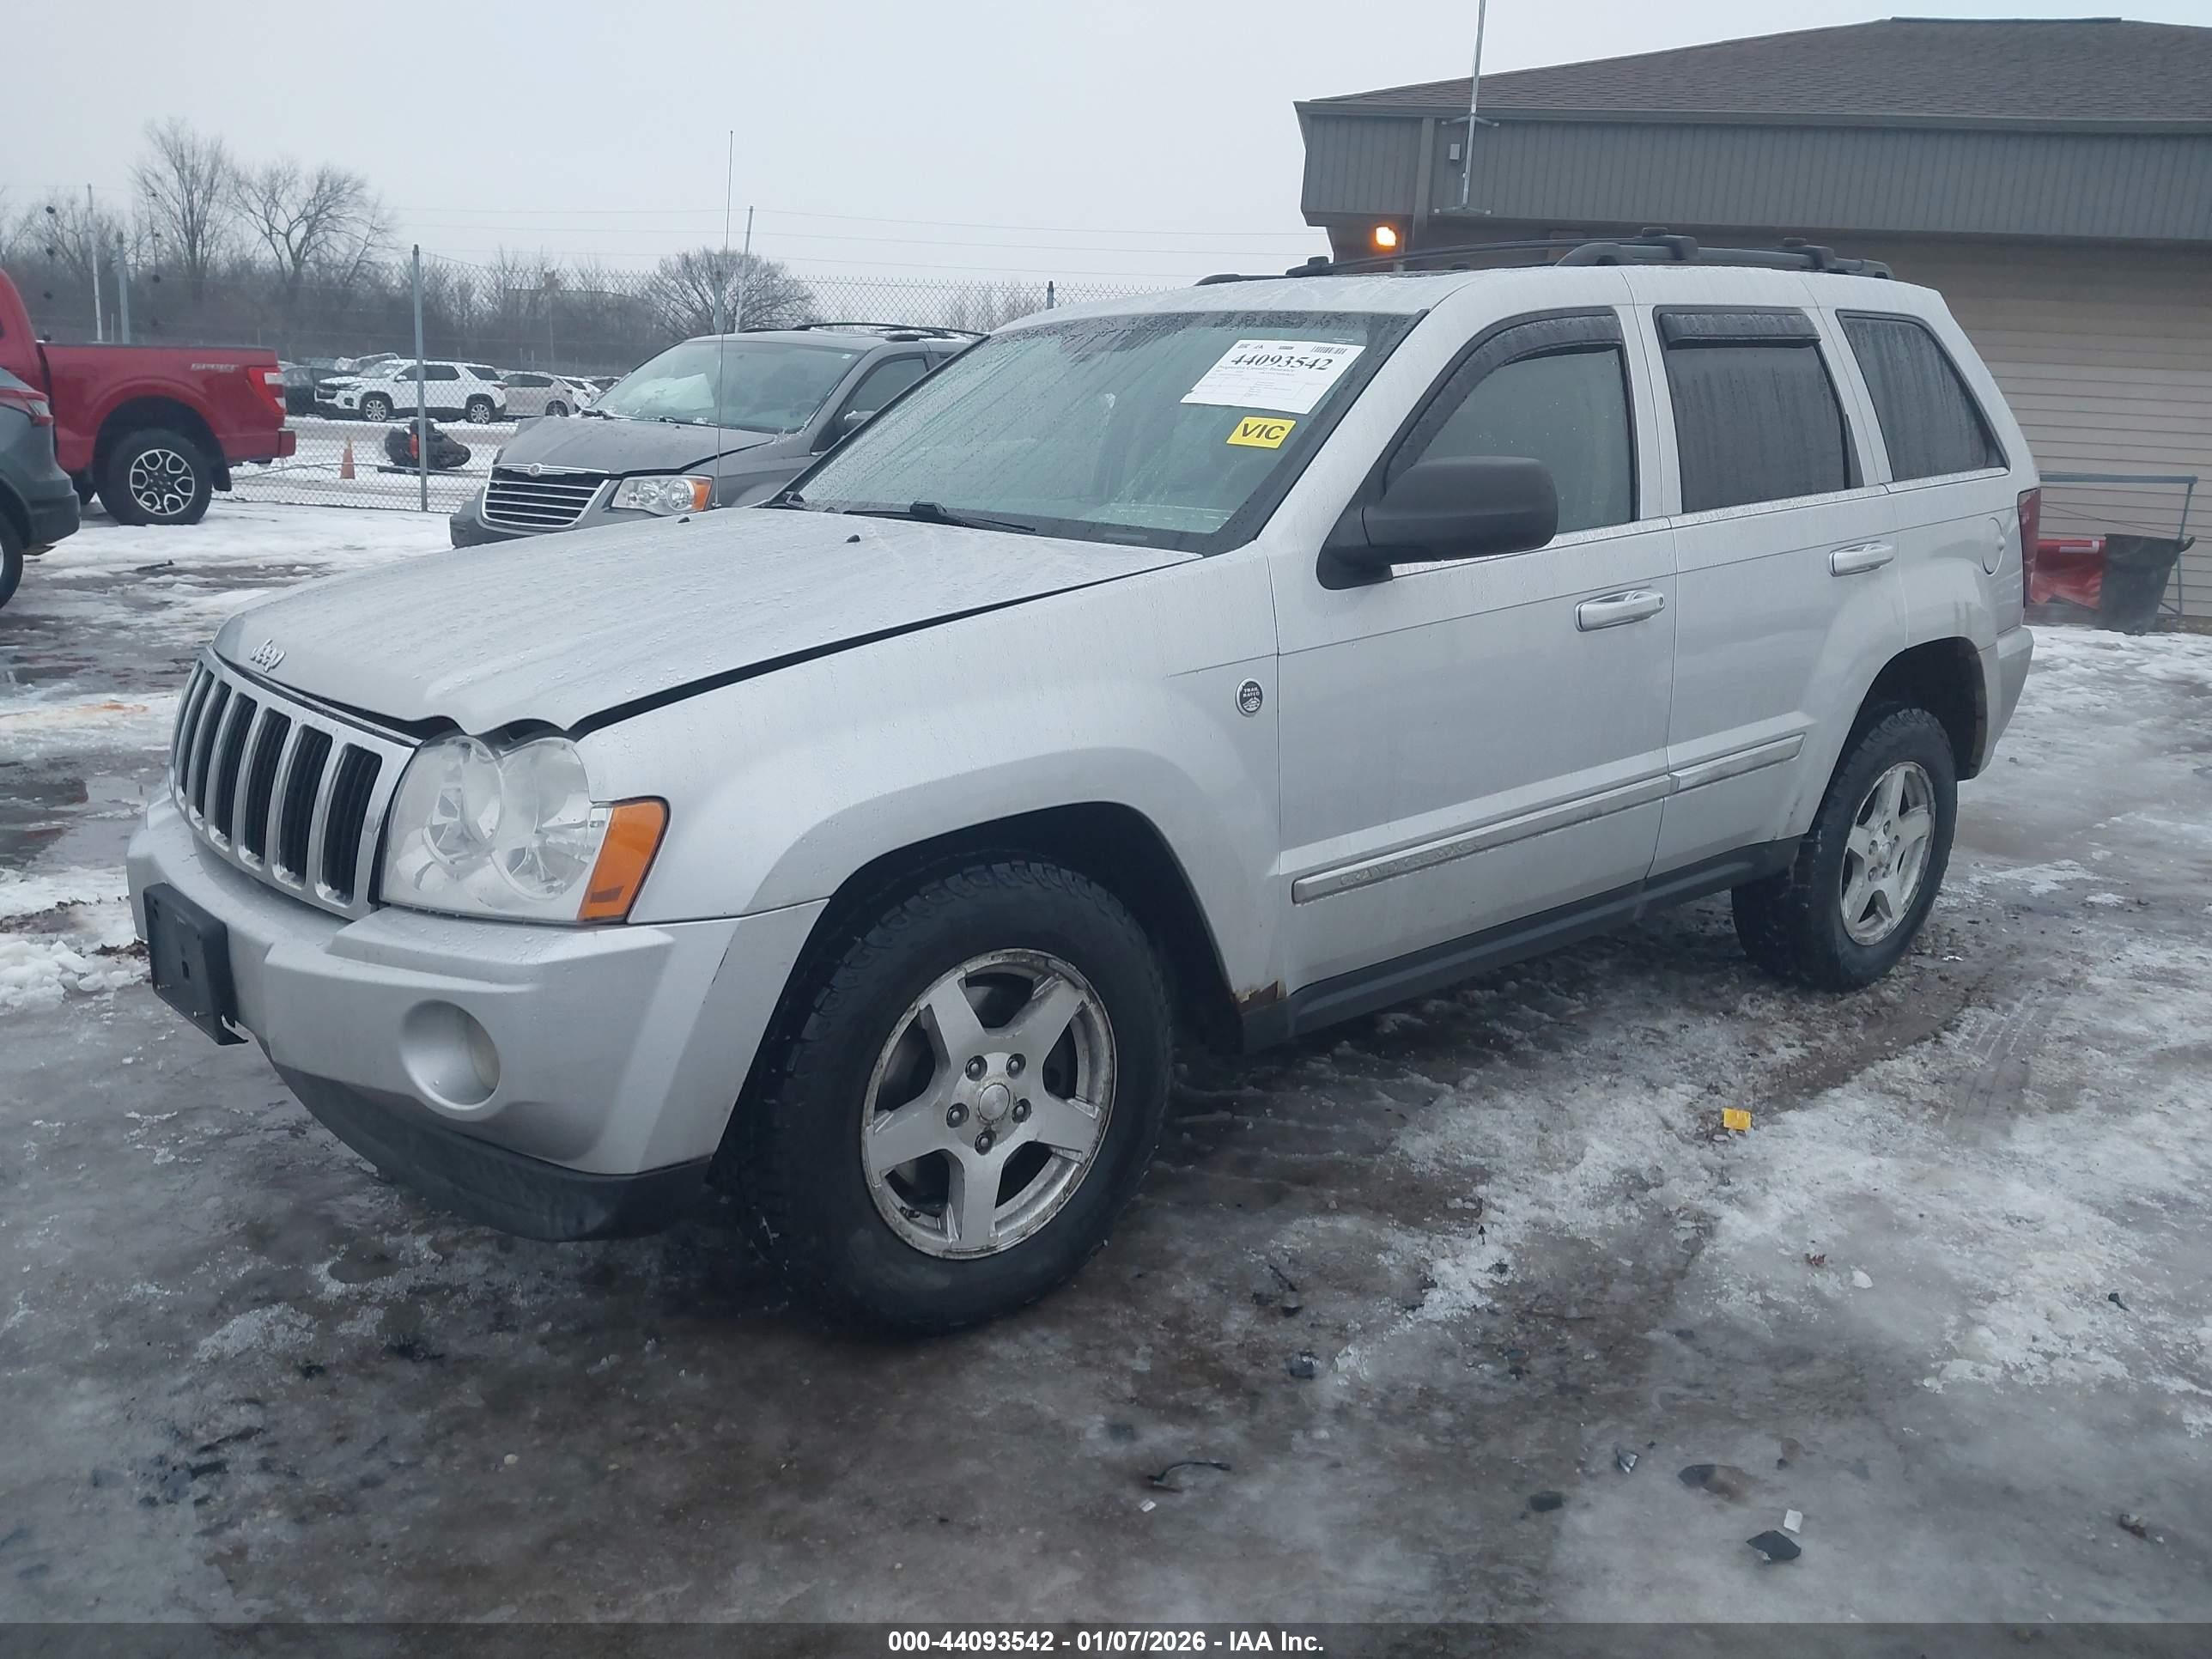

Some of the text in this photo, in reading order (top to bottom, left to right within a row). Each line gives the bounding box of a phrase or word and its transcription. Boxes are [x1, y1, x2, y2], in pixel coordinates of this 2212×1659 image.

[1231, 354, 1334, 370] 44093542
[1242, 422, 1285, 440] VIC
[251, 639, 286, 673] Jeep
